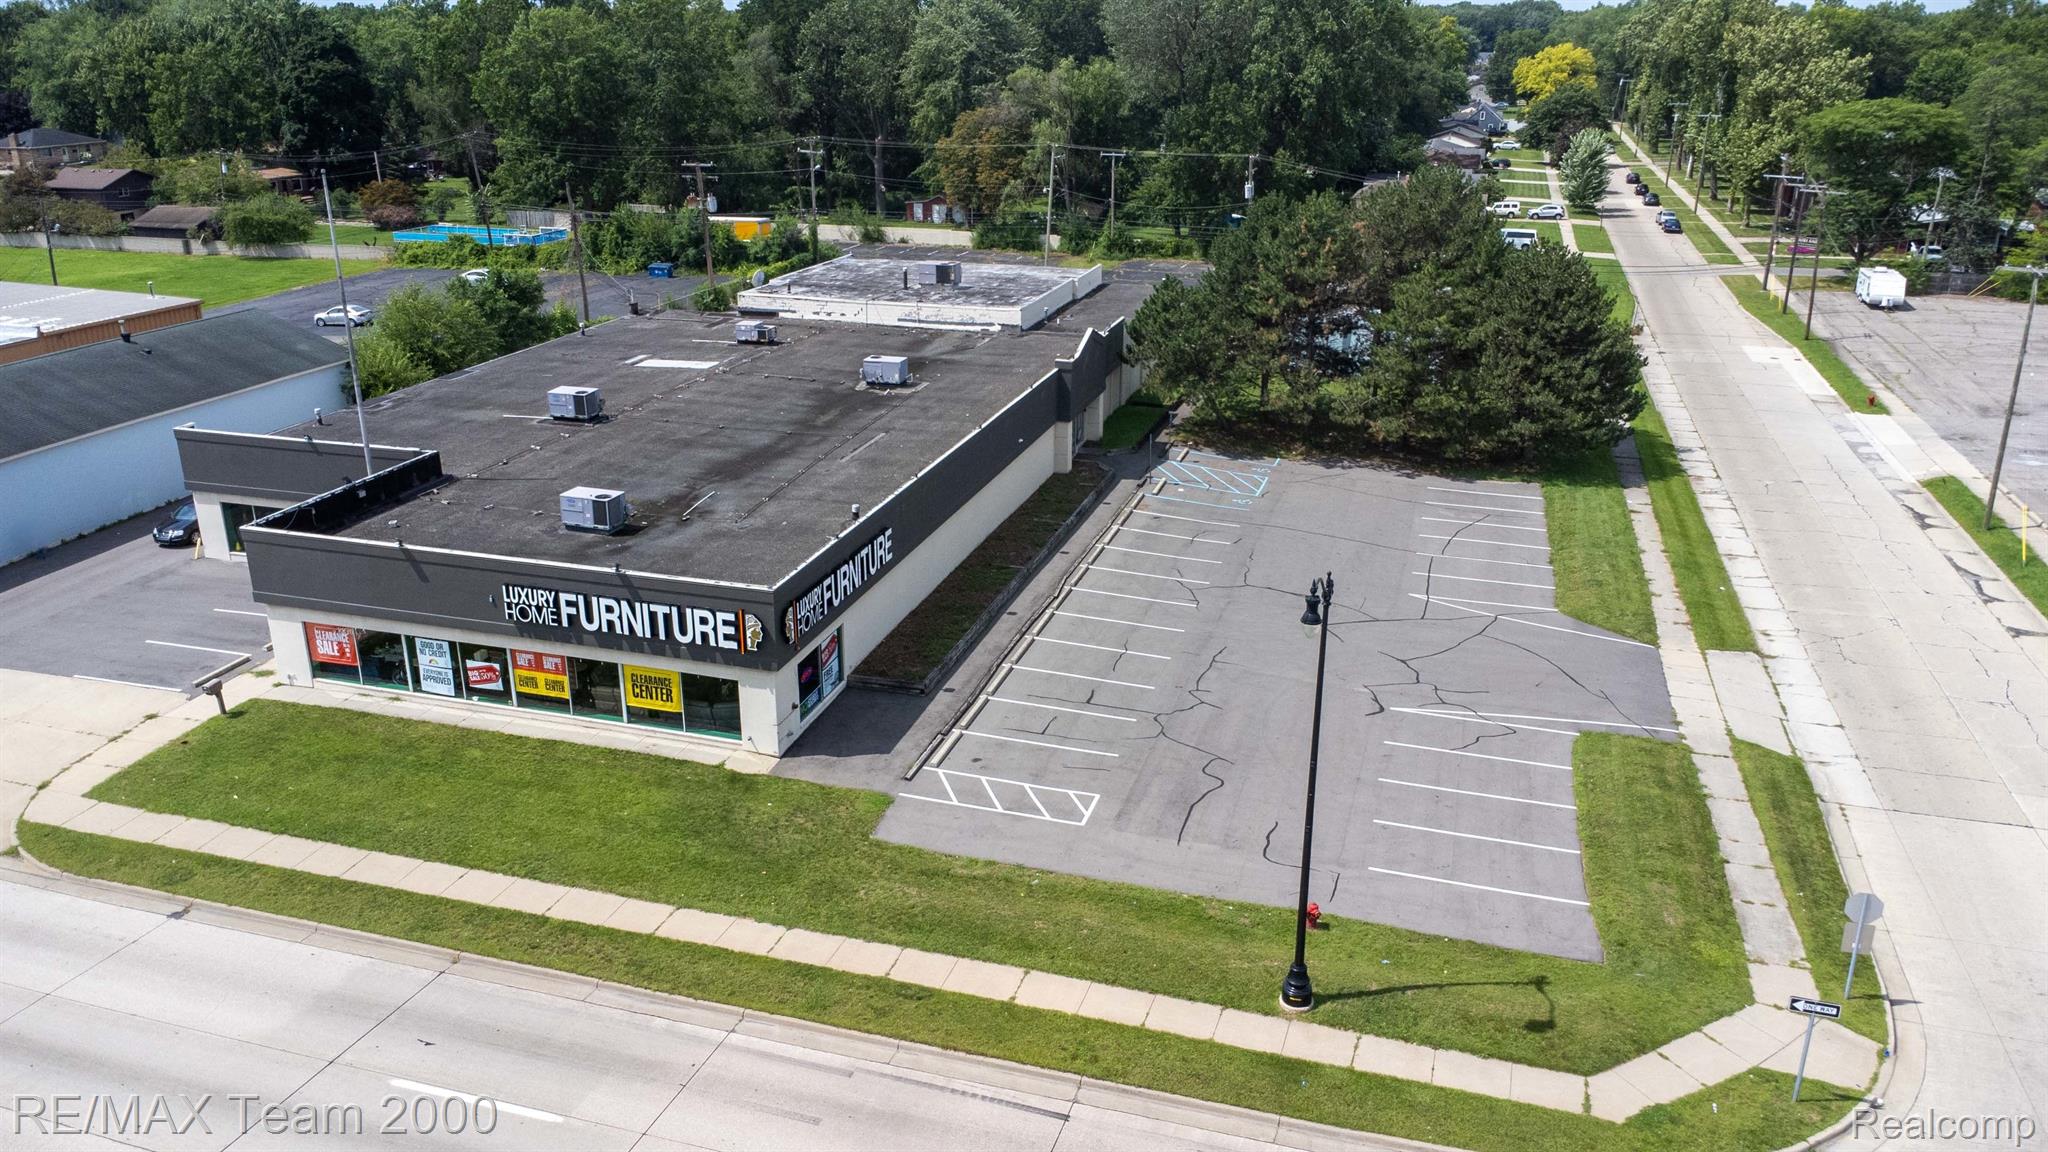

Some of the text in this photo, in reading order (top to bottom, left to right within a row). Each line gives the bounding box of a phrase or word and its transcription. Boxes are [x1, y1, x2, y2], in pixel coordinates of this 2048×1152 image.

[823, 528, 893, 615] FURNITURE
[502, 585, 556, 608] LUXURY
[797, 584, 822, 619] LUXURY
[503, 602, 558, 627] HOME
[558, 592, 739, 650] FURNITURE
[798, 601, 823, 638] HOME
[316, 639, 340, 656] SALE
[422, 673, 452, 686] APPROVED
[631, 672, 672, 688] CLEARANCE
[631, 682, 673, 703] CENTER
[1803, 1003, 1835, 1014] ONE WAY
